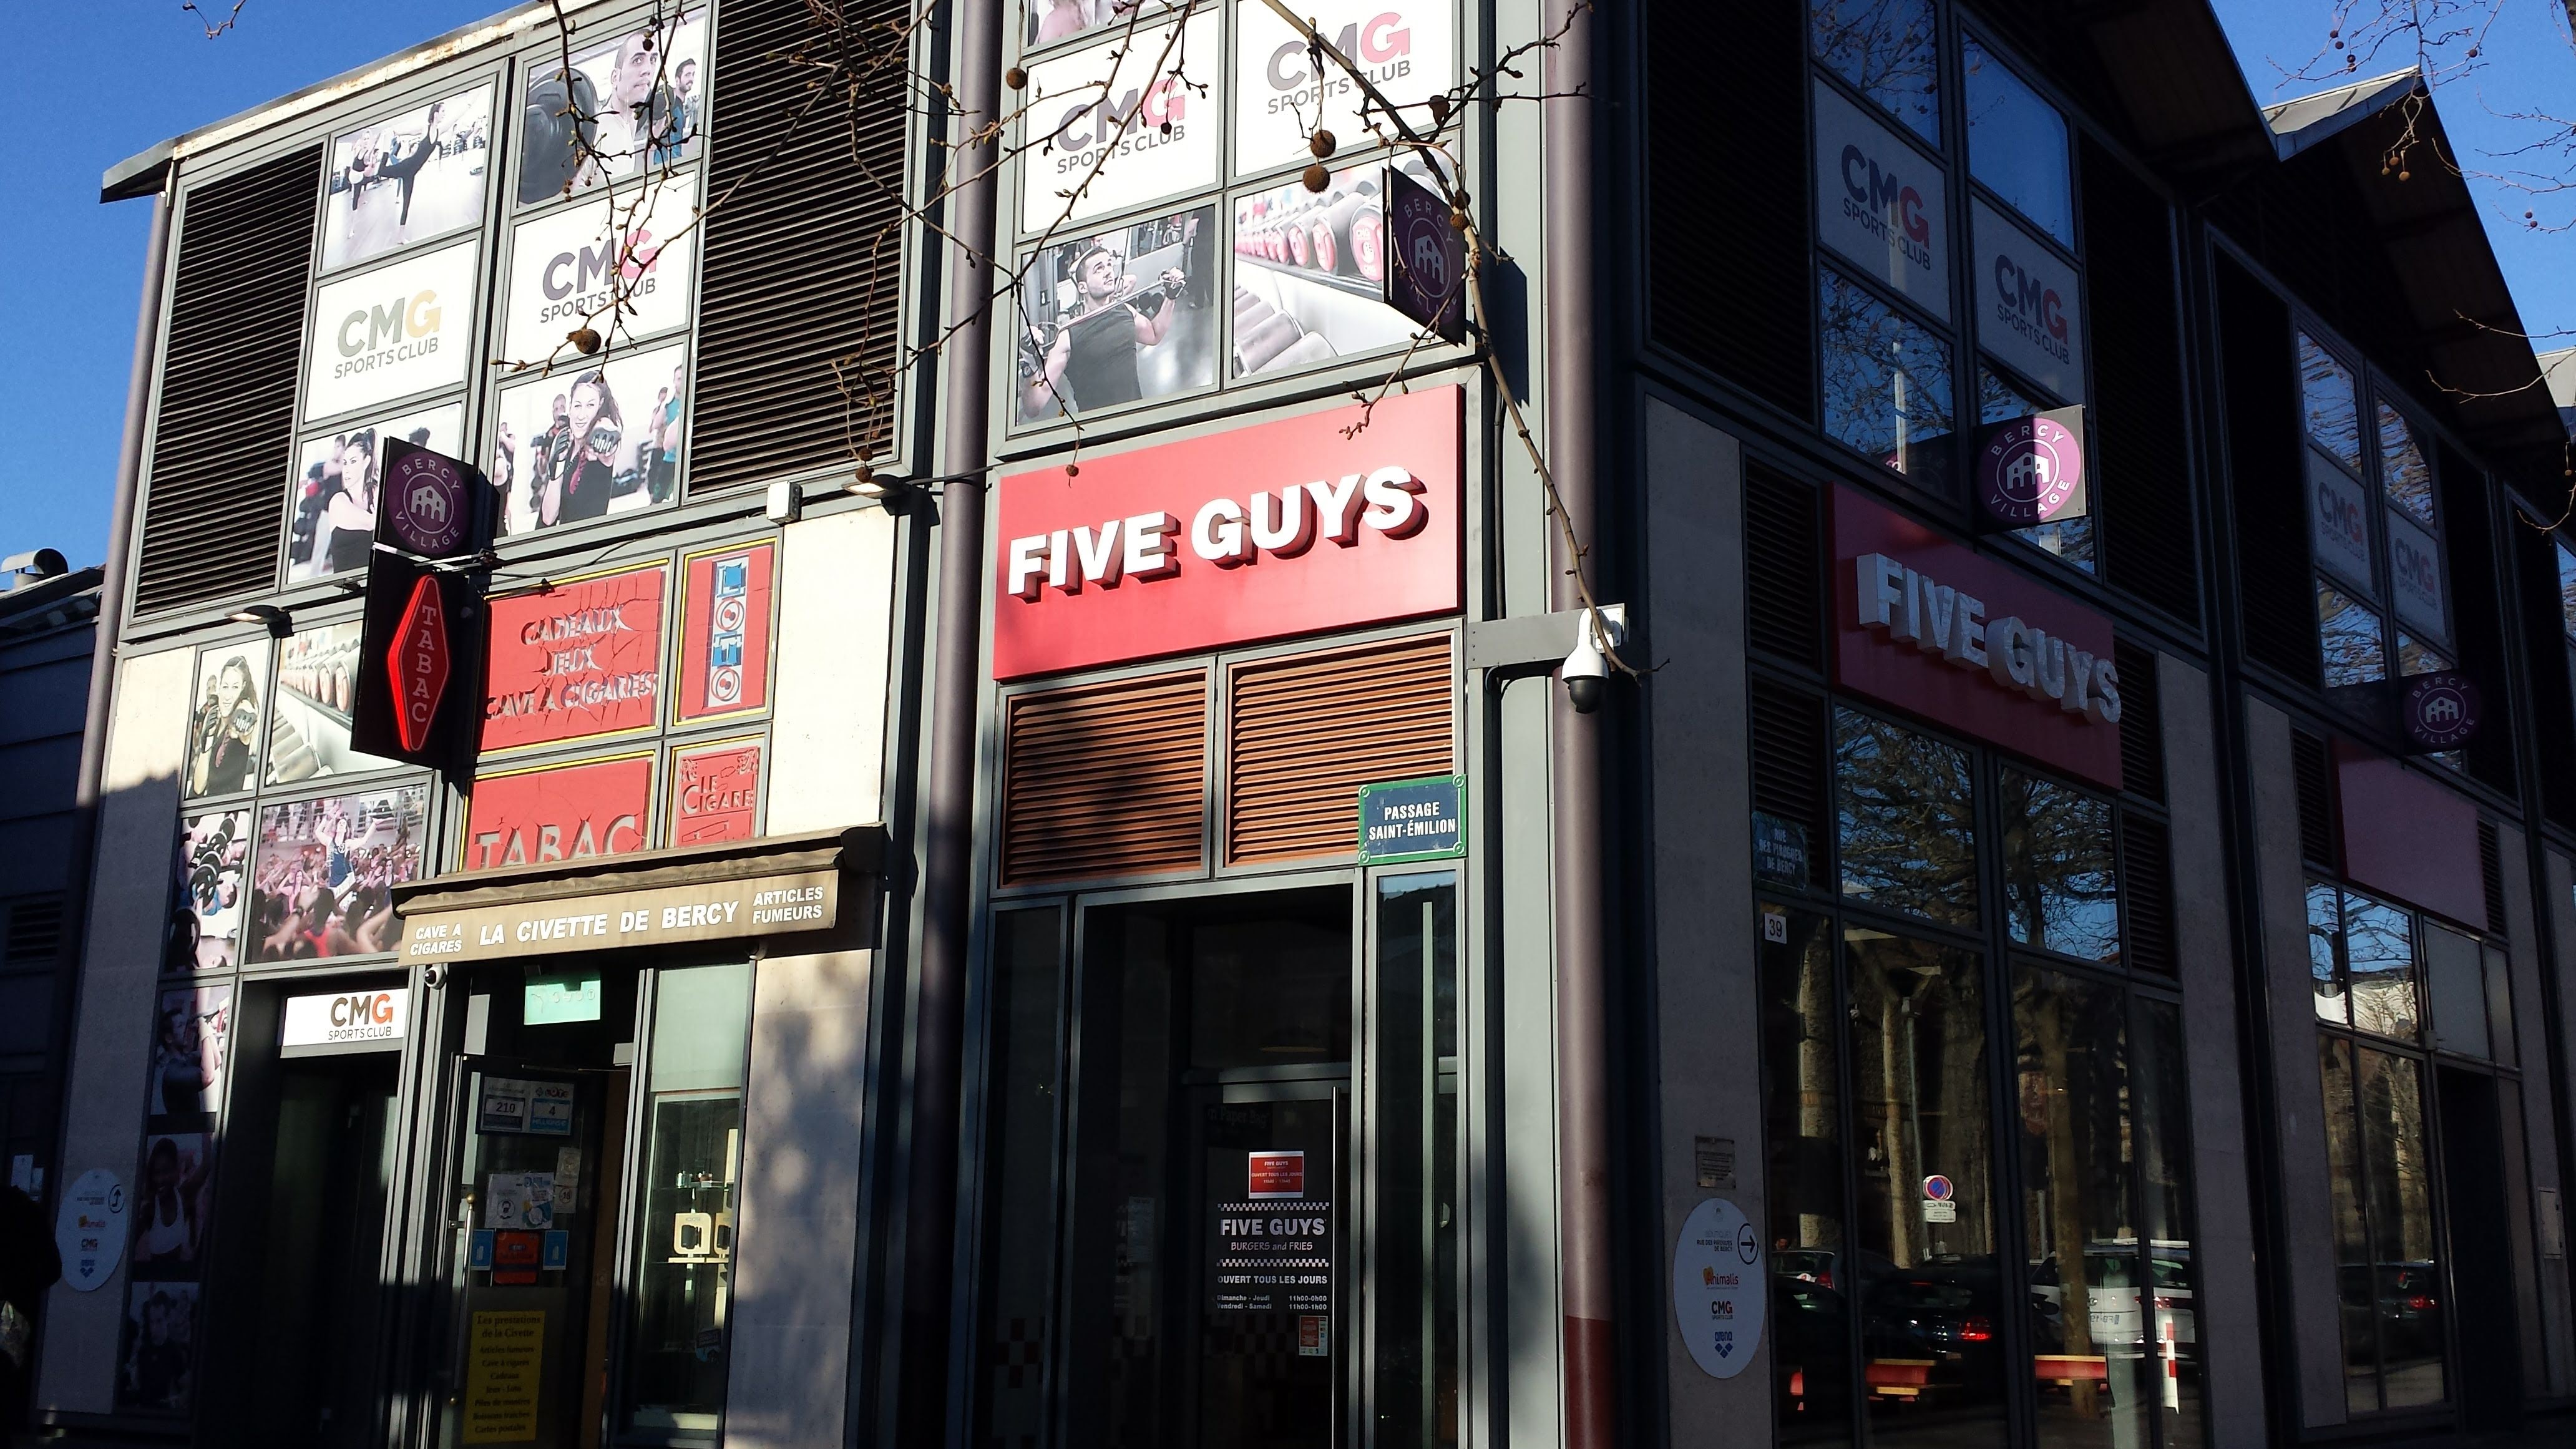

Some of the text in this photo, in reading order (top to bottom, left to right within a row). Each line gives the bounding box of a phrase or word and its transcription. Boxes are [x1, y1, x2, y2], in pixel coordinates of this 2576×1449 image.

[1267, 12, 1410, 91] CMG
[1267, 77, 1350, 115] SPORTS
[1057, 79, 1186, 152] CMG
[1134, 125, 1186, 152] CLUB
[1841, 144, 1930, 250] CMG
[1403, 197, 1455, 245] BERCY
[1842, 198, 1931, 271] SPORTS CLUB
[542, 229, 658, 301] CMG
[540, 291, 607, 324] SPORTS
[1995, 255, 2069, 345] CMG
[338, 290, 442, 358] CMG
[1996, 305, 2071, 366] SPORTS CLUB
[334, 337, 439, 379] SPORTS CLUB
[1991, 423, 2065, 456] BERCY
[401, 457, 461, 490] BERCY
[1989, 479, 2071, 519] VILLAGE
[2318, 482, 2363, 544] CMG
[395, 510, 460, 549] VILLAGE
[1007, 466, 1427, 600] FIVE GUYS
[2396, 538, 2436, 593] CMG
[521, 603, 632, 645] CADEAUX
[1856, 552, 2122, 724] FIVE GUYS
[412, 605, 437, 723] TABAC
[540, 643, 603, 678] JEUX
[485, 693, 536, 720] CAVE
[560, 671, 659, 708] CIGARES
[2412, 676, 2469, 699] BERCY
[2414, 718, 2476, 744] VILLAGE
[682, 784, 753, 814] CIGARE
[1384, 801, 1440, 821] PASSAGE
[475, 814, 637, 868] TABAC
[1368, 818, 1456, 841] SAINT-ÉMILION
[1759, 838, 1772, 853] DES
[1773, 827, 1787, 842] RUE
[1767, 856, 1796, 875] DE BERCY
[753, 886, 823, 906] ARTICLES
[479, 901, 739, 945] LA CIVETTE DE BERCY
[752, 904, 822, 924] FUMEURS
[1769, 919, 1782, 938] 39
[409, 939, 462, 956] CIGARES
[416, 923, 462, 940] CAVE A
[330, 993, 394, 1027] CMG
[328, 1027, 392, 1041] SPORTS CLUB
[496, 1102, 515, 1113] 210
[549, 1106, 556, 1116] 4
[1220, 1218, 1325, 1236] FIVE GUYS
[1231, 1241, 1313, 1251] BURGERS and FRIES
[1217, 1276, 1328, 1284] OUVERT TOUS LES JOURS
[1706, 1271, 1739, 1286] Animalis
[477, 1314, 540, 1327] Les prestations
[1712, 1300, 1733, 1315] CMG
[482, 1328, 493, 1337] de
[504, 1328, 534, 1337] Civette
[1715, 1331, 1733, 1342] arena
[475, 1426, 497, 1434] Cartes
